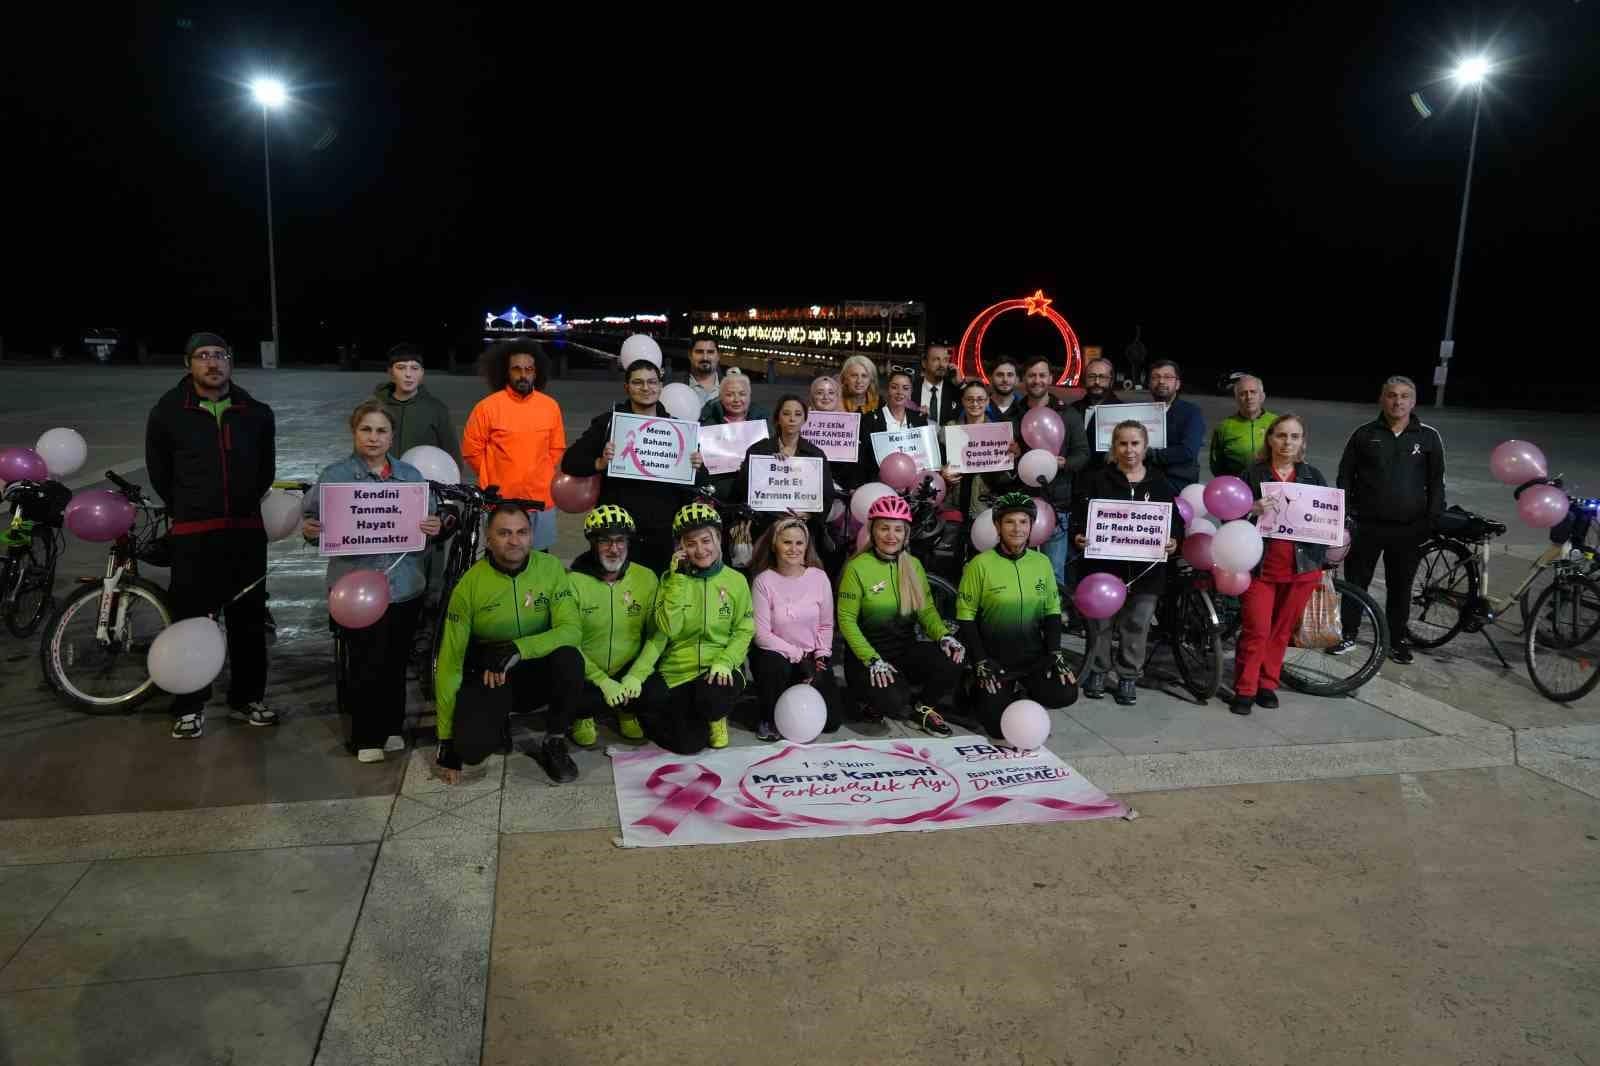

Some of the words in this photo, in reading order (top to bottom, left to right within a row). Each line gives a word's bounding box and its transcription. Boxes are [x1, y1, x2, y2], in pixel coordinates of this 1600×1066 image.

[646, 427, 671, 436] Meme
[643, 437, 673, 448] Bahane
[354, 489, 399, 499] Kendini
[350, 505, 402, 515] Tanımak,
[1312, 500, 1339, 511] Bana
[1097, 510, 1128, 519] Pembe
[1130, 512, 1164, 521] Sadece
[357, 520, 395, 531] Hayatı
[1096, 523, 1109, 531] Bir
[1111, 523, 1134, 532] Renk
[342, 535, 408, 545] Kollamaktır
[1096, 535, 1109, 543] Bir
[1111, 535, 1161, 545] Farkındalık
[752, 773, 837, 784] Meme
[841, 766, 938, 780] Kanseri
